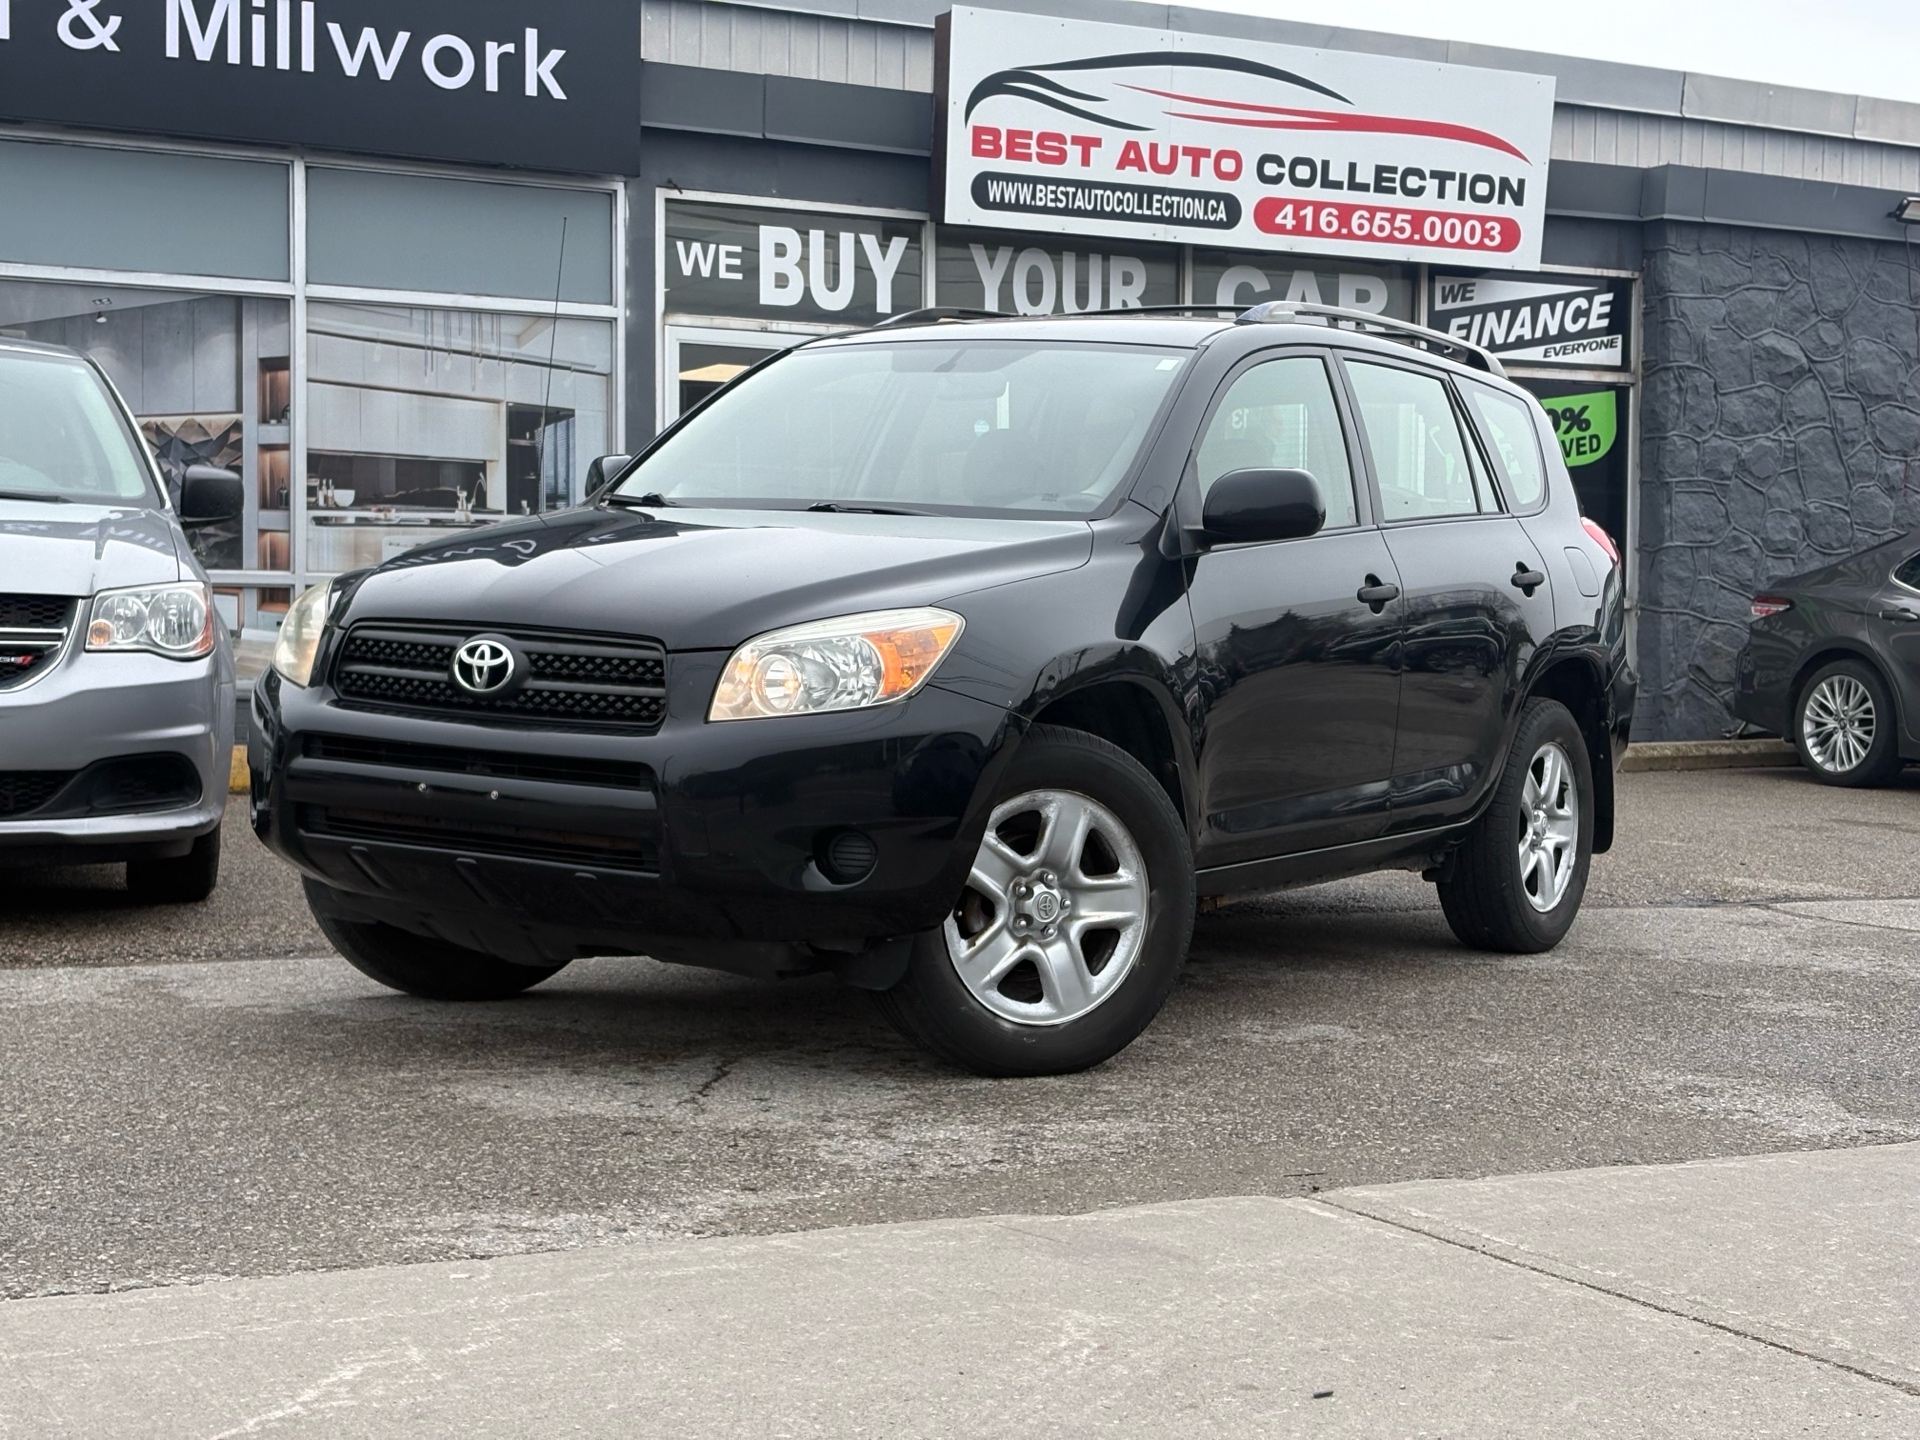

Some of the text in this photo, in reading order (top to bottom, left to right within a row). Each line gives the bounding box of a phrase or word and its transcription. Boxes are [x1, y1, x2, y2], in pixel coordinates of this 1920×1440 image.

[57, 0, 122, 51] &
[165, 0, 567, 100] Millwork
[971, 125, 1526, 206] BEST AUTO COLLECTION
[987, 178, 1228, 223] WWW.BESTAUTOCOLLECTION.CA
[676, 225, 1388, 332] WE BUY YOUR CAR
[1441, 282, 1476, 305] WE
[1445, 292, 1614, 350] FINANCE
[1543, 337, 1619, 359] EVERYONE
